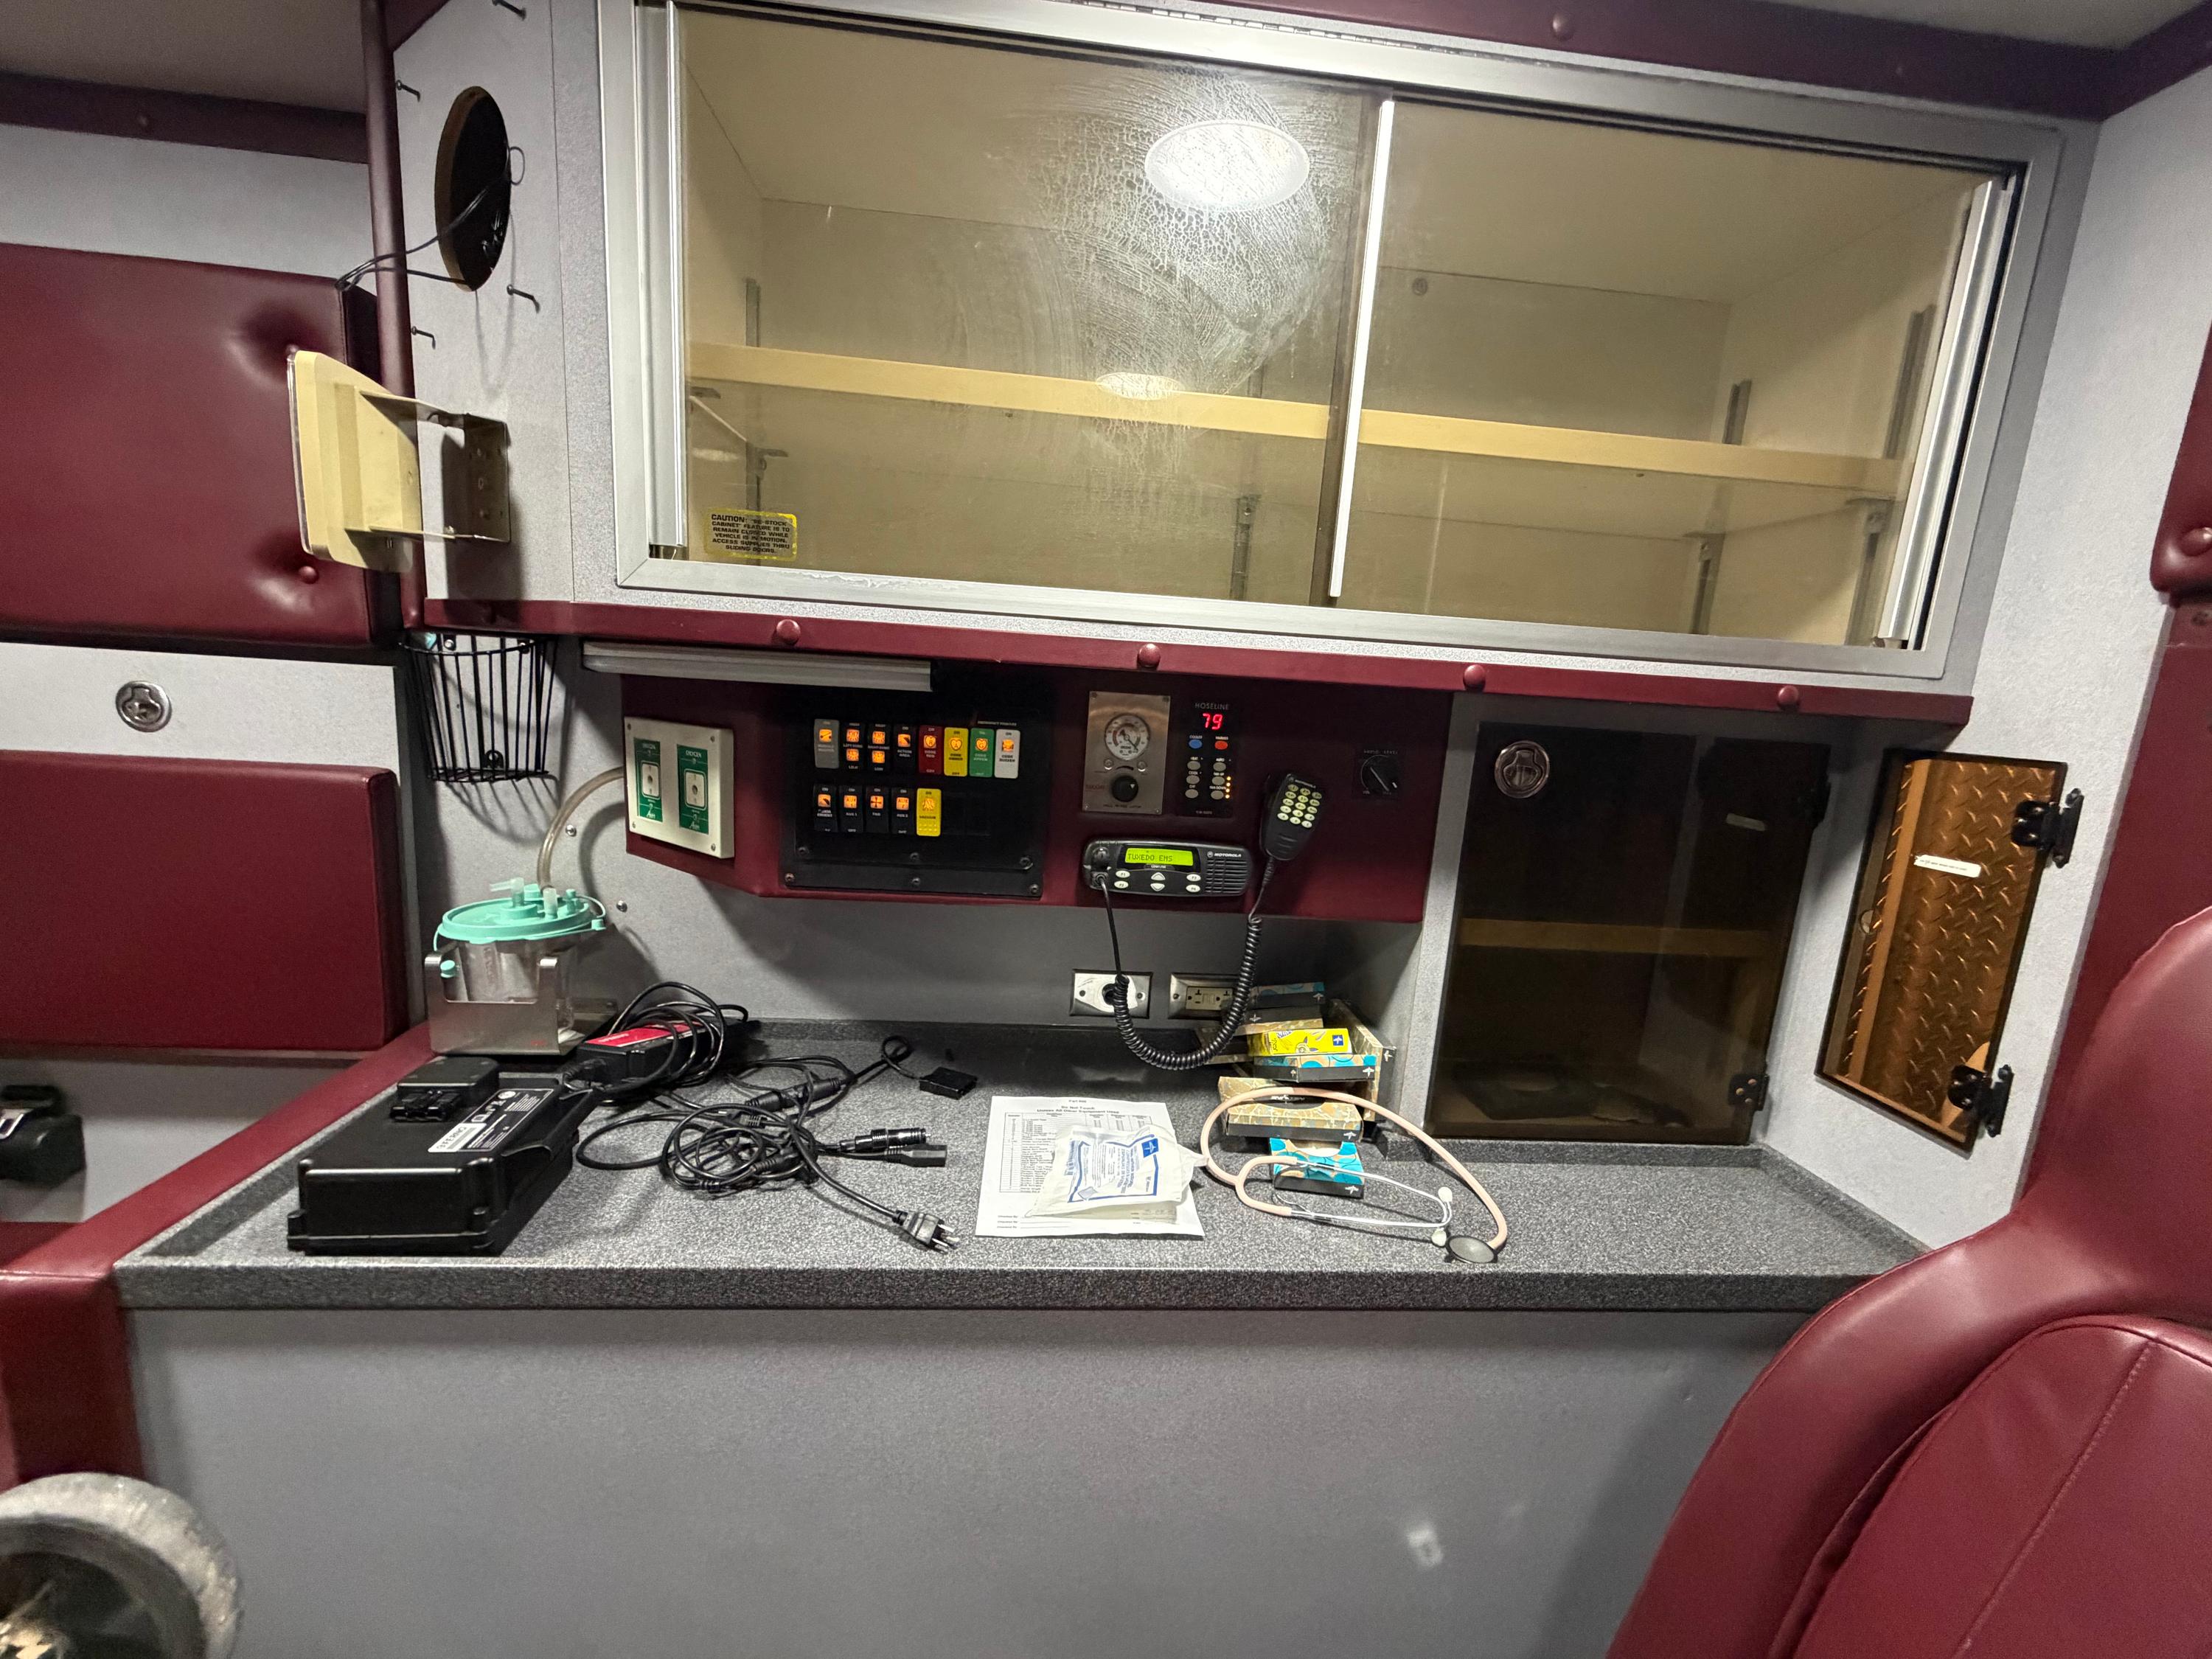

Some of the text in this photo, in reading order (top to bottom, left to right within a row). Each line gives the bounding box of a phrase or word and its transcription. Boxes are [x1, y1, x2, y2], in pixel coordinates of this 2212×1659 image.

[712, 514, 748, 523] CAUTION:
[1194, 702, 1229, 710] HOSELINE
[1202, 712, 1223, 730] 79
[1127, 853, 1173, 862] TUXEDO EMS
